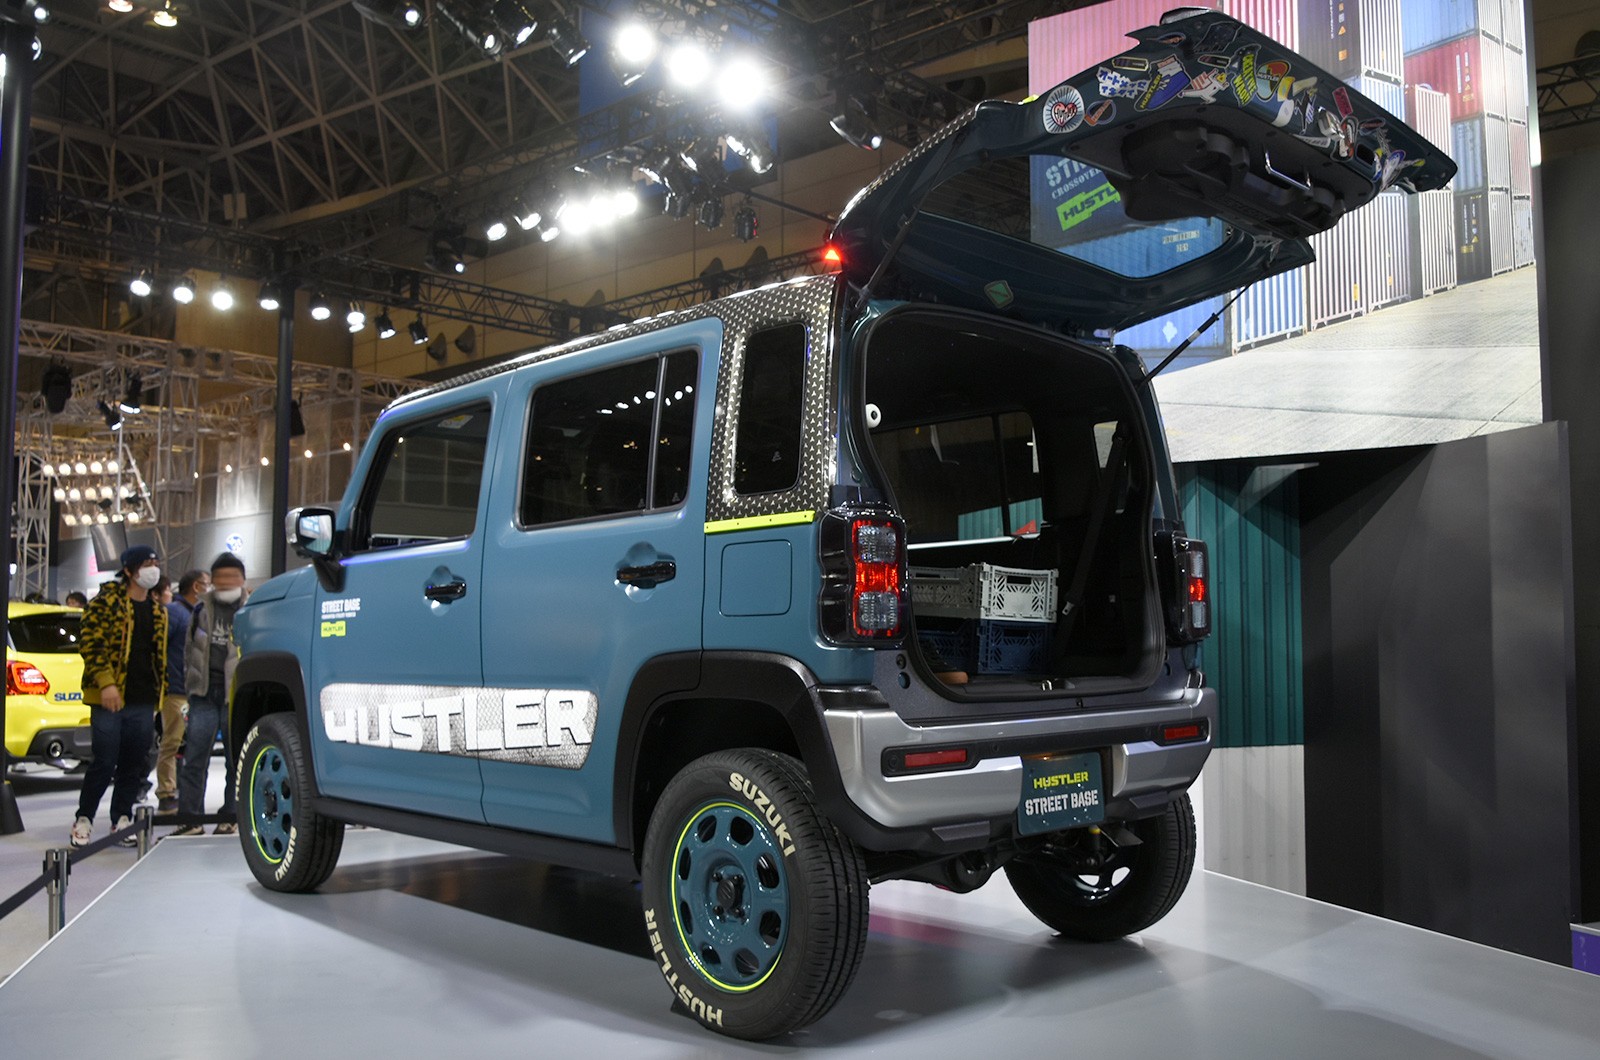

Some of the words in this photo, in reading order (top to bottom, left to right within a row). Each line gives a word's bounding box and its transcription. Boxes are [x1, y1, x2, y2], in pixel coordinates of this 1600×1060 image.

[325, 688, 593, 752] HUSTLER
[1025, 794, 1069, 816] STREET
[1071, 789, 1099, 809] BASE
[1033, 771, 1089, 789] HUSTLER
[728, 772, 796, 857] SUZUKI
[274, 825, 297, 882] SUZUKI
[644, 908, 724, 1028] HUSTLER
